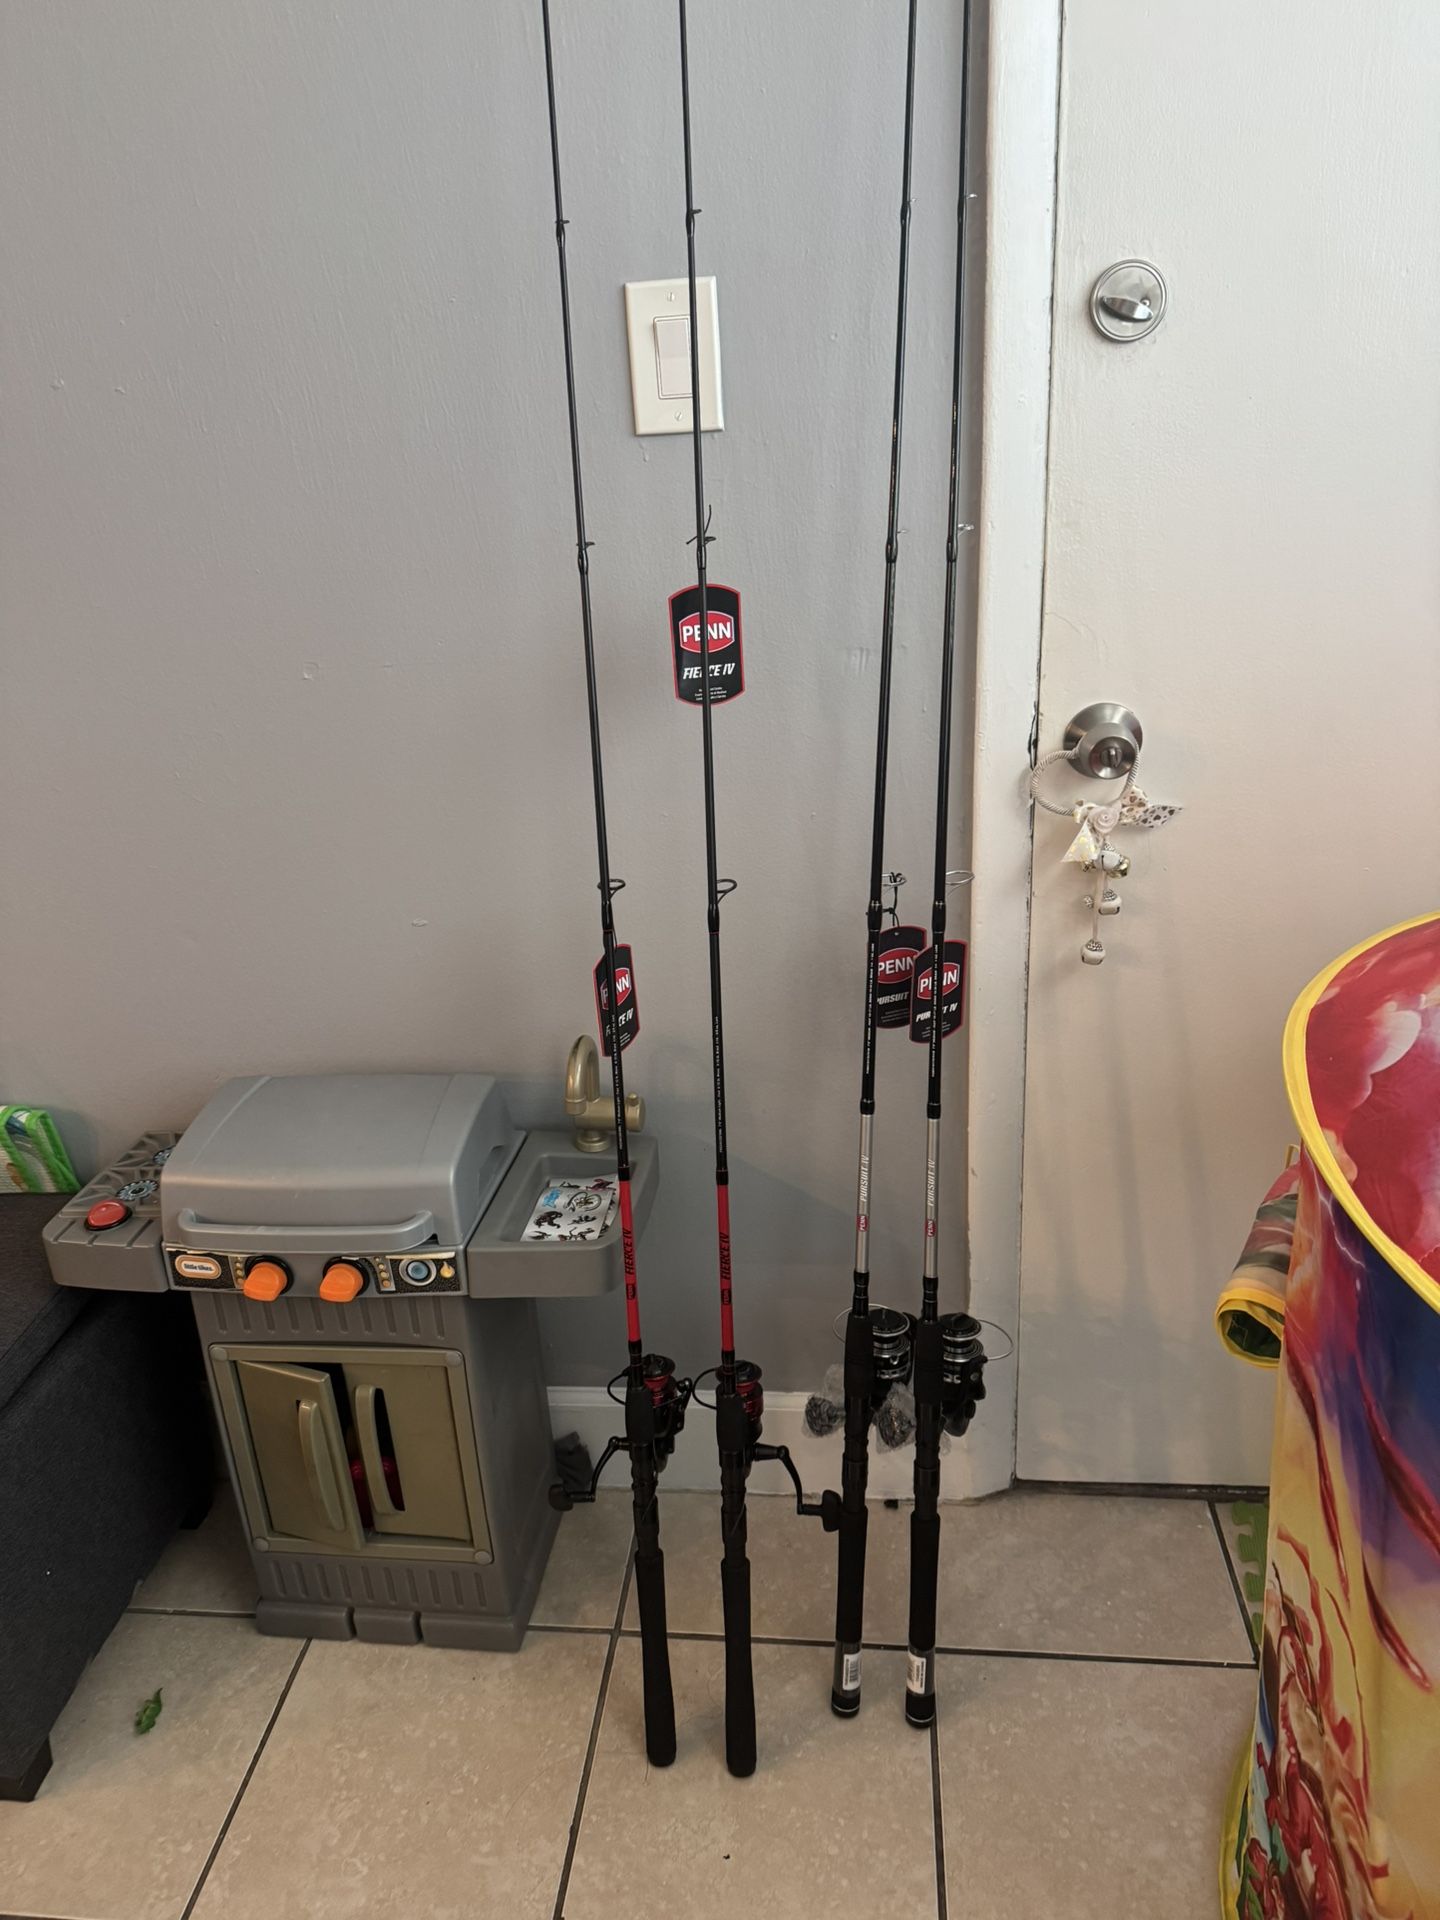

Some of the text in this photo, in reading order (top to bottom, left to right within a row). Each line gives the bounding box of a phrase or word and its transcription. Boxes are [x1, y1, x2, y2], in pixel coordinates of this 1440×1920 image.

[682, 662, 736, 680] FIECE IV
[602, 974, 629, 1004] PNN
[860, 1154, 870, 1164] IV
[927, 1158, 936, 1168] IV
[860, 1166, 869, 1202] PURSUIT
[927, 1170, 935, 1207] PURSUIT
[623, 1240, 635, 1275] FIERCE
[719, 1245, 731, 1280] FIERCE
